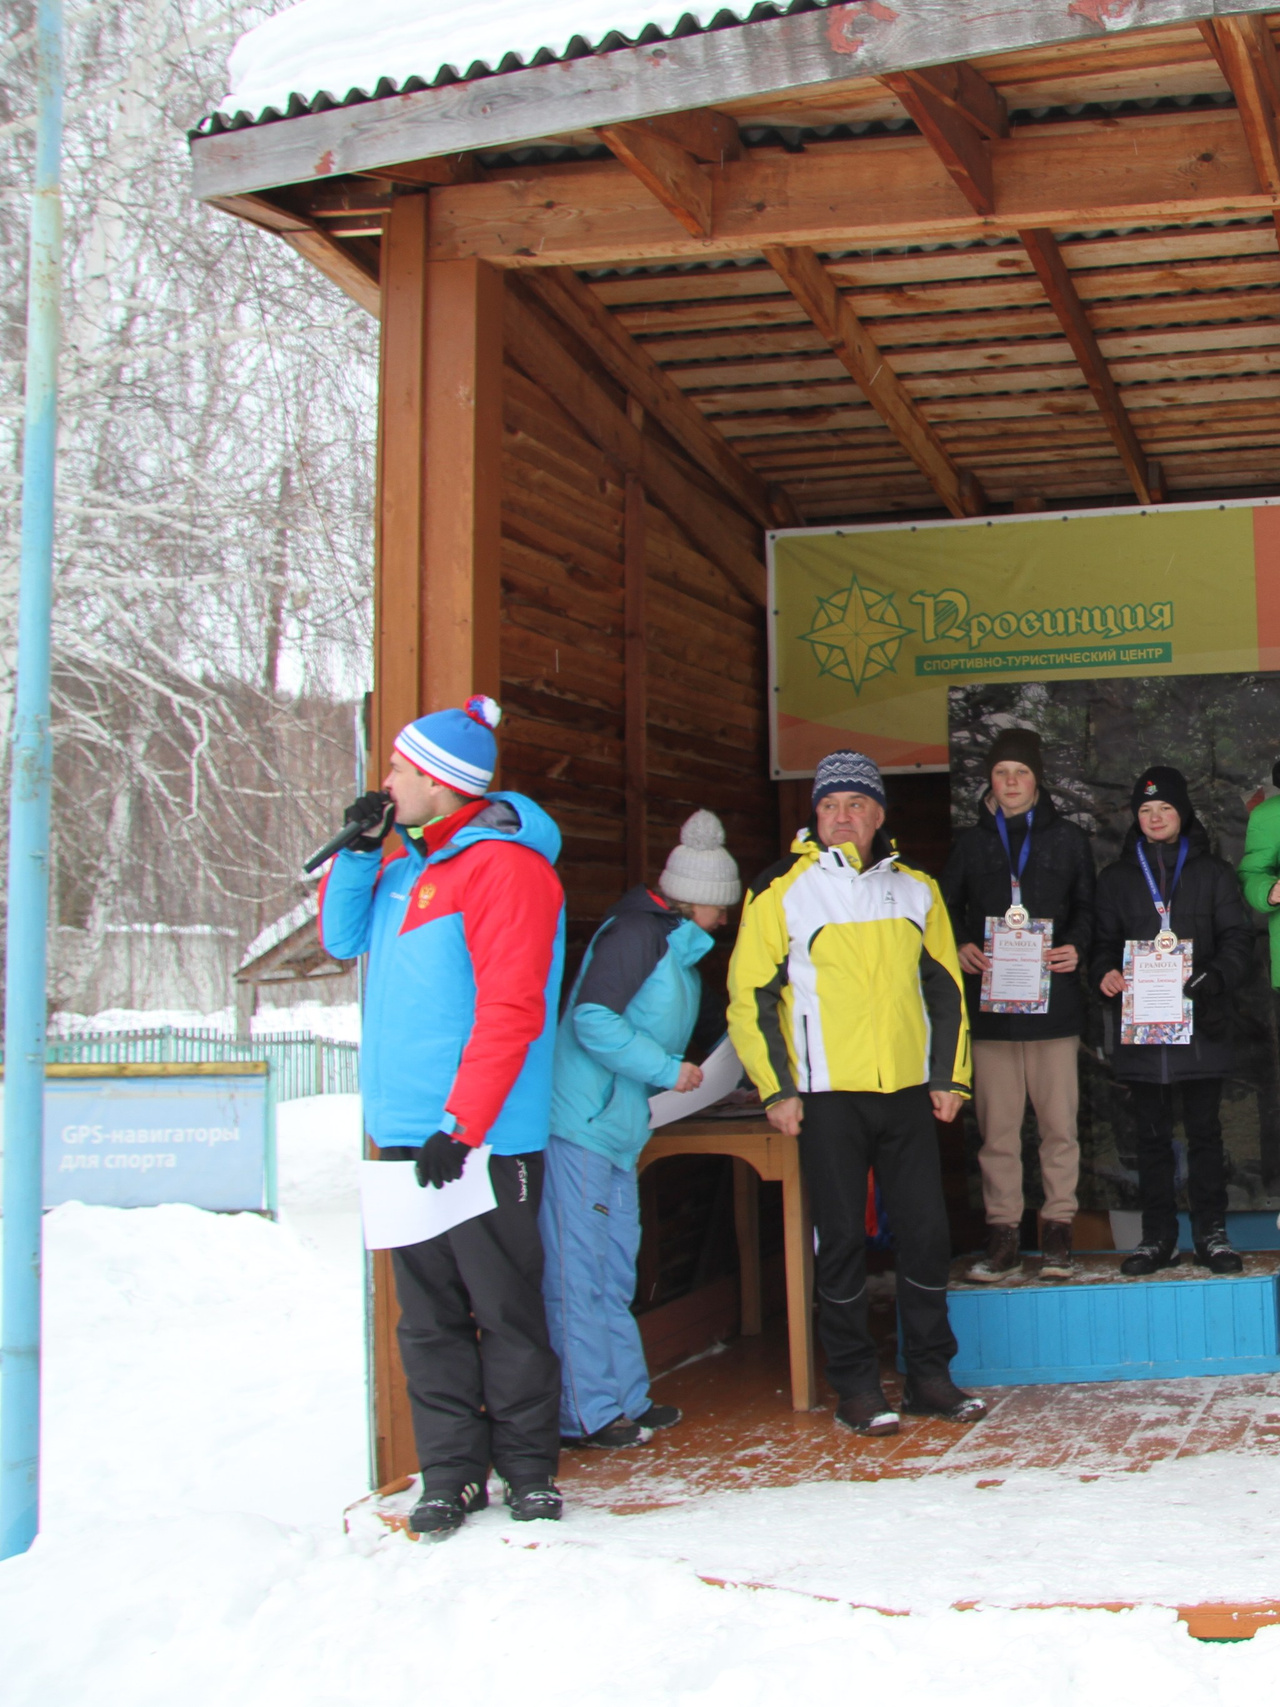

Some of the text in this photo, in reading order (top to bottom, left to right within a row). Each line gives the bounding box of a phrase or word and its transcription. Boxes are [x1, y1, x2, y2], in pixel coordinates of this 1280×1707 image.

[908, 588, 1173, 649] Провинция
[923, 647, 1163, 672] СПОРТИВНО-ТУРИСТИЧЕСКИЙ ЦЕНТР
[1139, 961, 1178, 969] ГРАМОТА
[61, 1125, 241, 1149] GPS-навигаторы
[59, 1153, 177, 1172] для спорта
